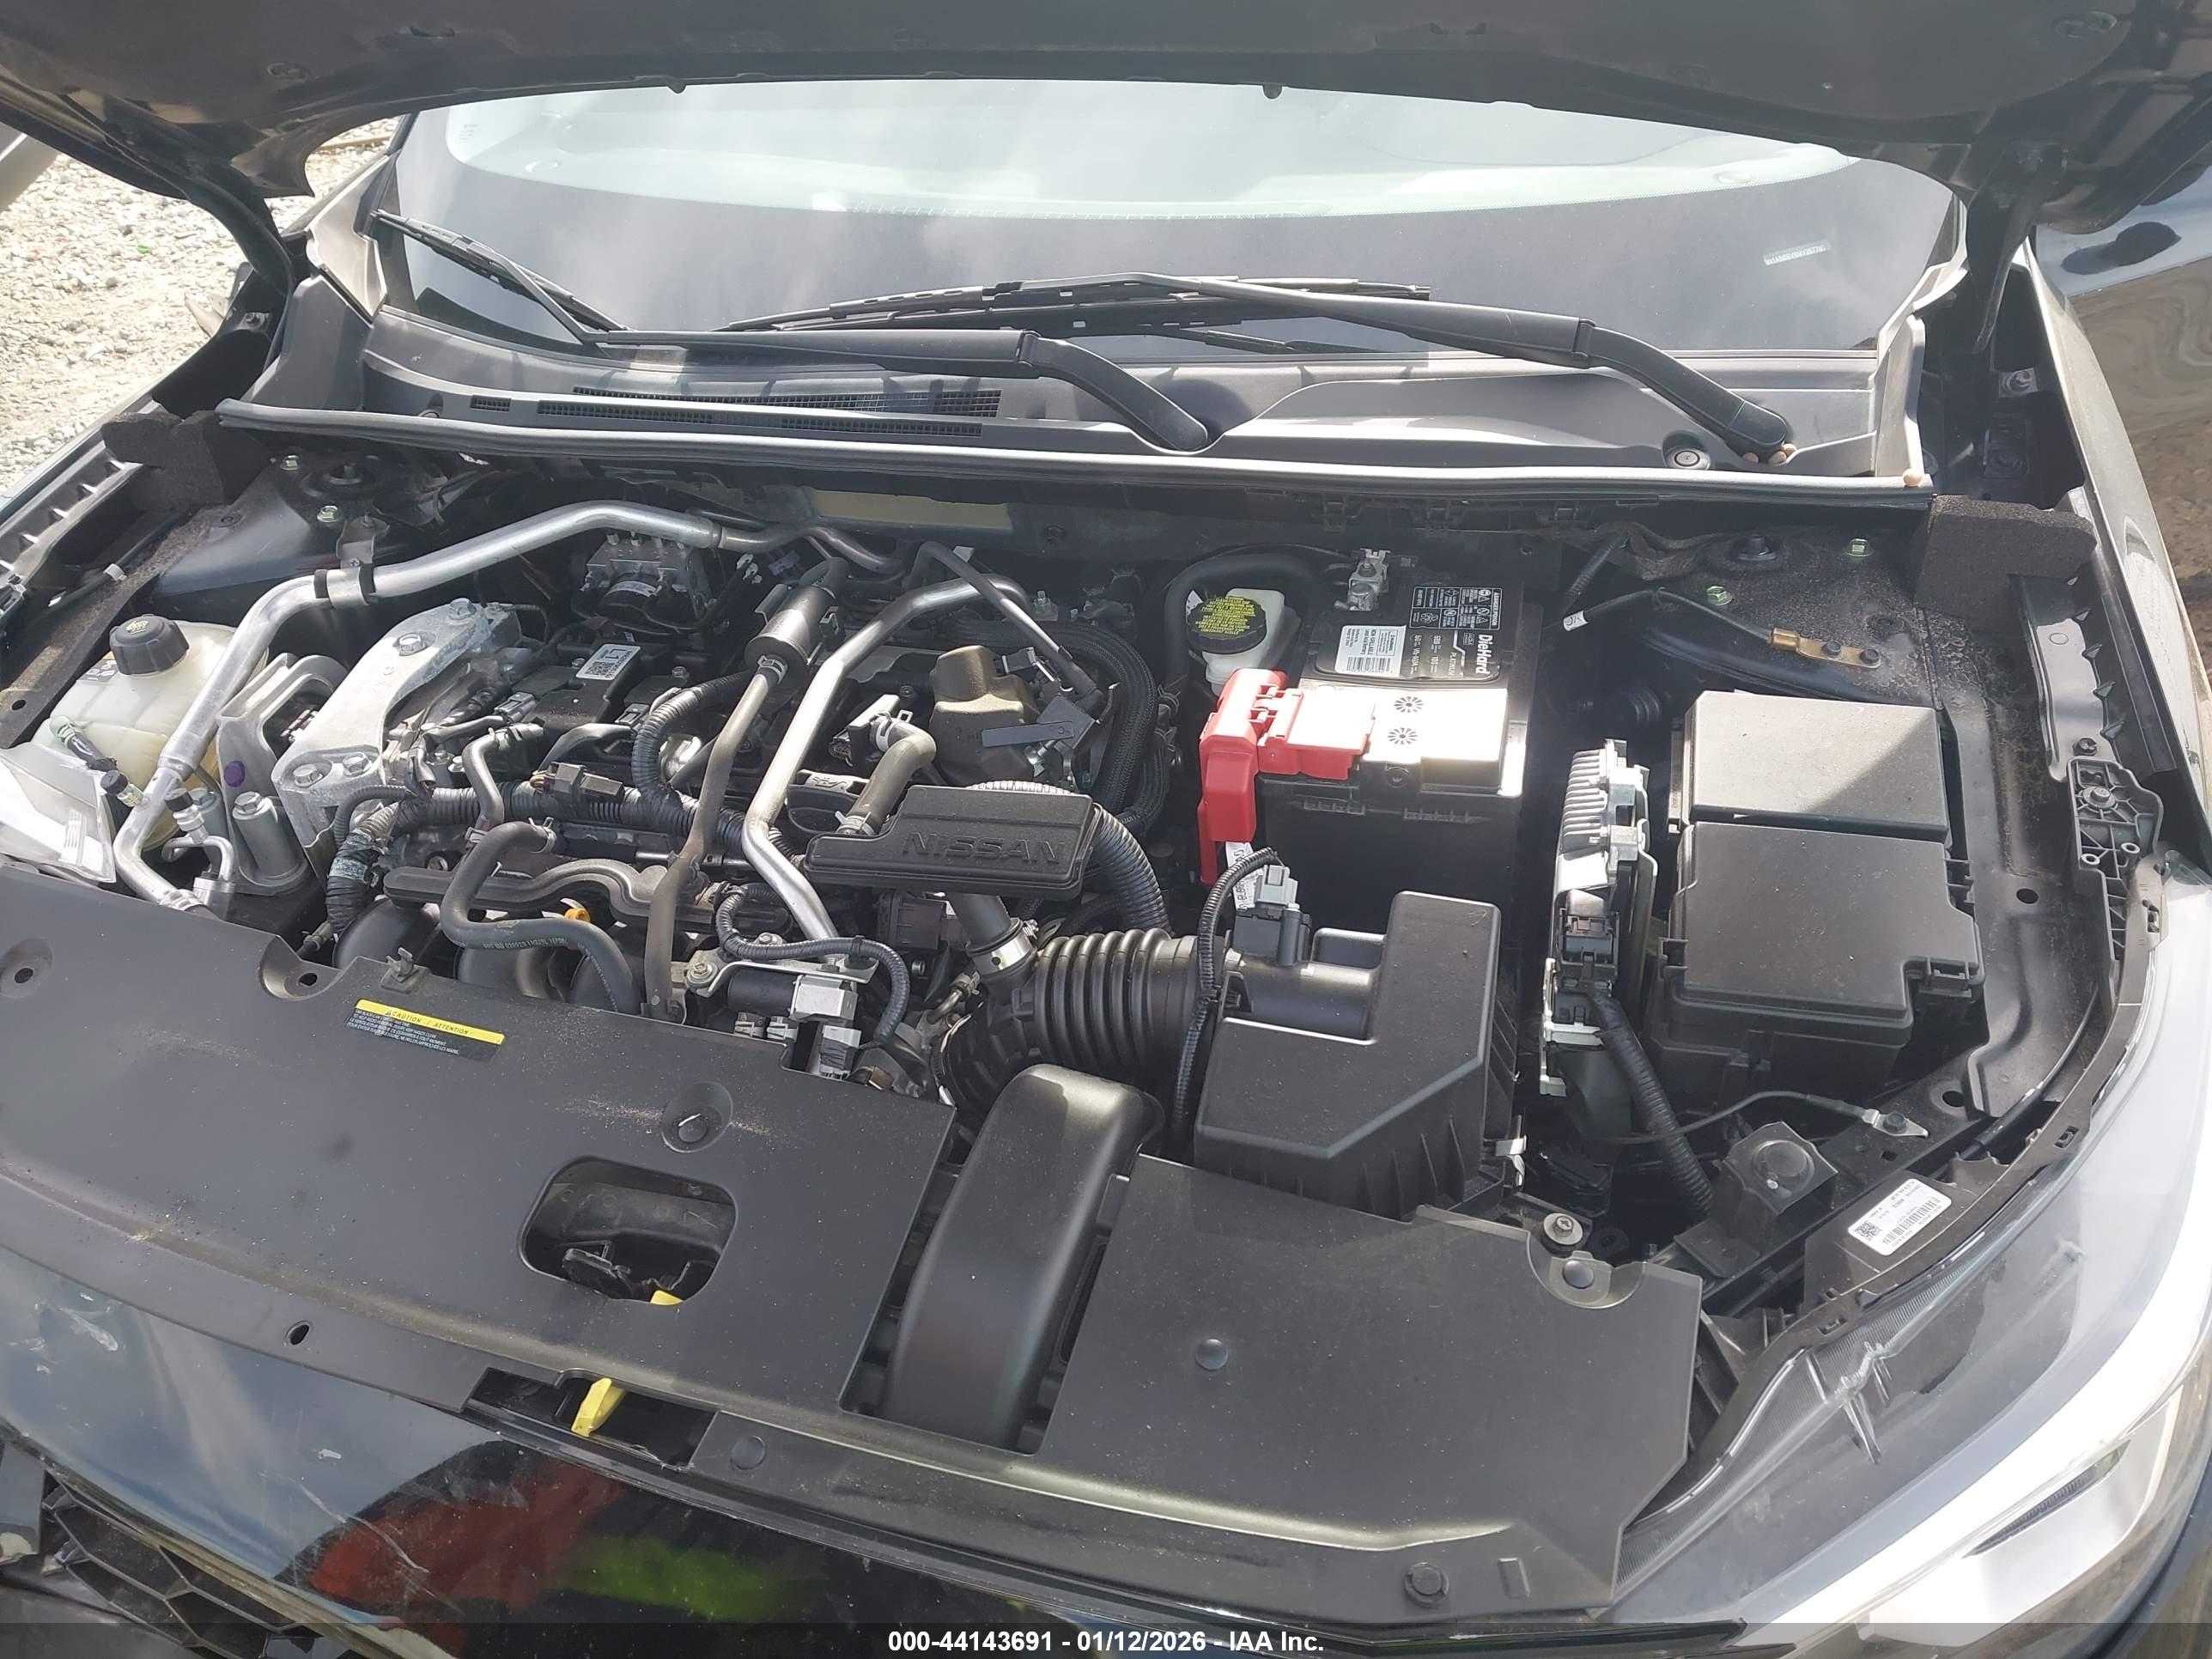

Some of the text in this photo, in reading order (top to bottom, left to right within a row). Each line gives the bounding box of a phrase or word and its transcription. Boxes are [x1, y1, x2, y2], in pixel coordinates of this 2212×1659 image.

[605, 648, 627, 659] L1
[1475, 634, 1494, 675] DieHard
[902, 831, 1066, 865] NISSAN
[392, 1011, 422, 1023] CAUTION
[433, 1022, 469, 1036] ATTENTION
